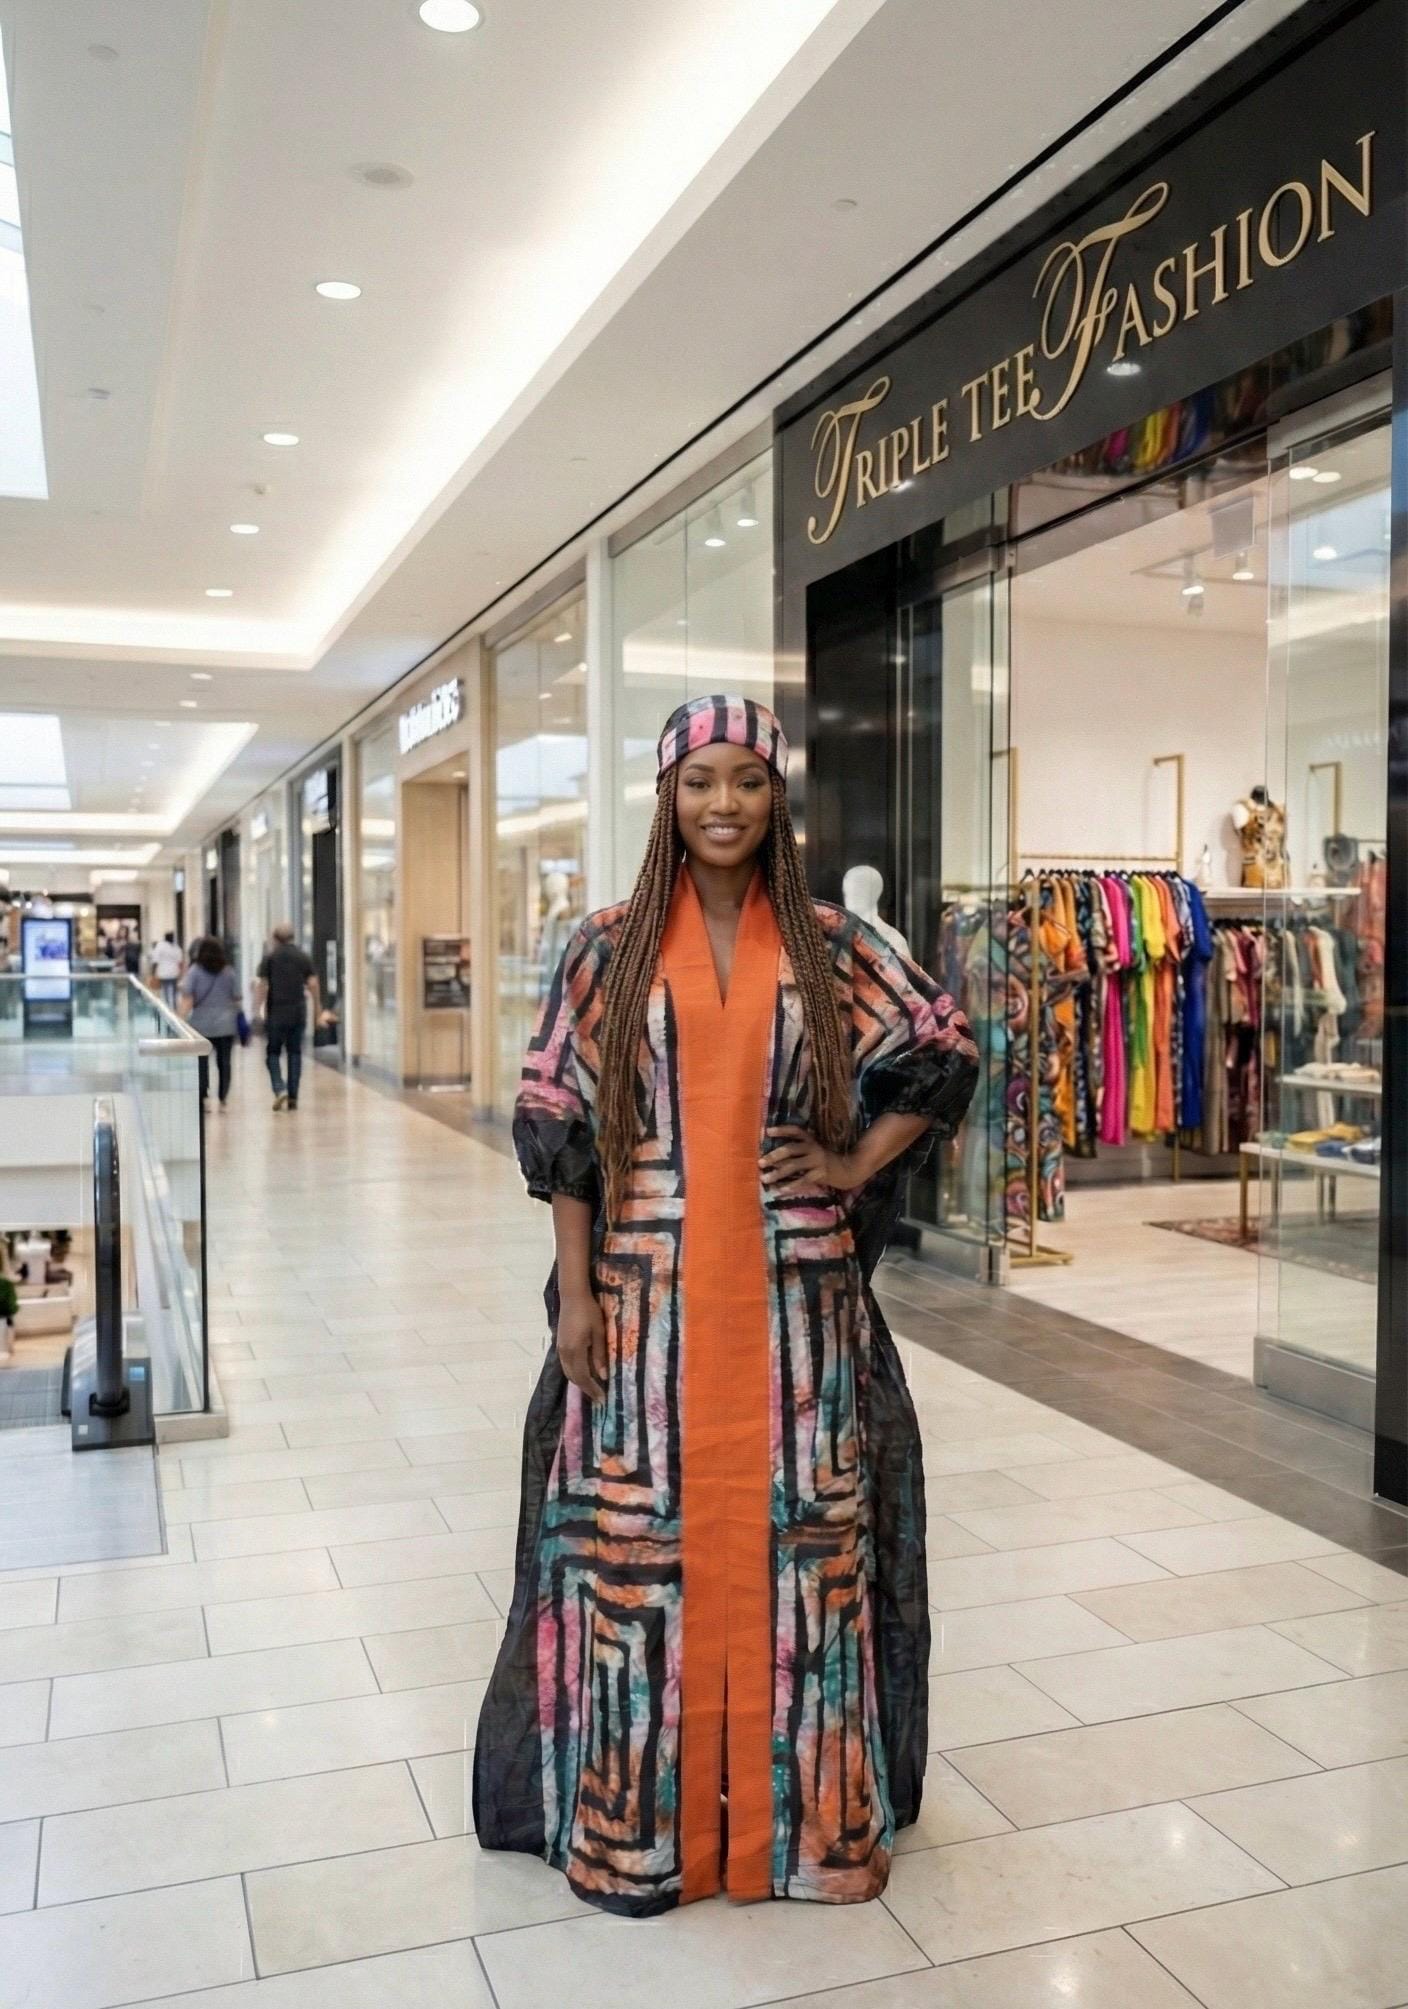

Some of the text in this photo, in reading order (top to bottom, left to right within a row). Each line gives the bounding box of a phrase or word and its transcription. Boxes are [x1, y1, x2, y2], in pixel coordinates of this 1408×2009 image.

[808, 130, 1376, 544] TRIPLE TEE FASHION
